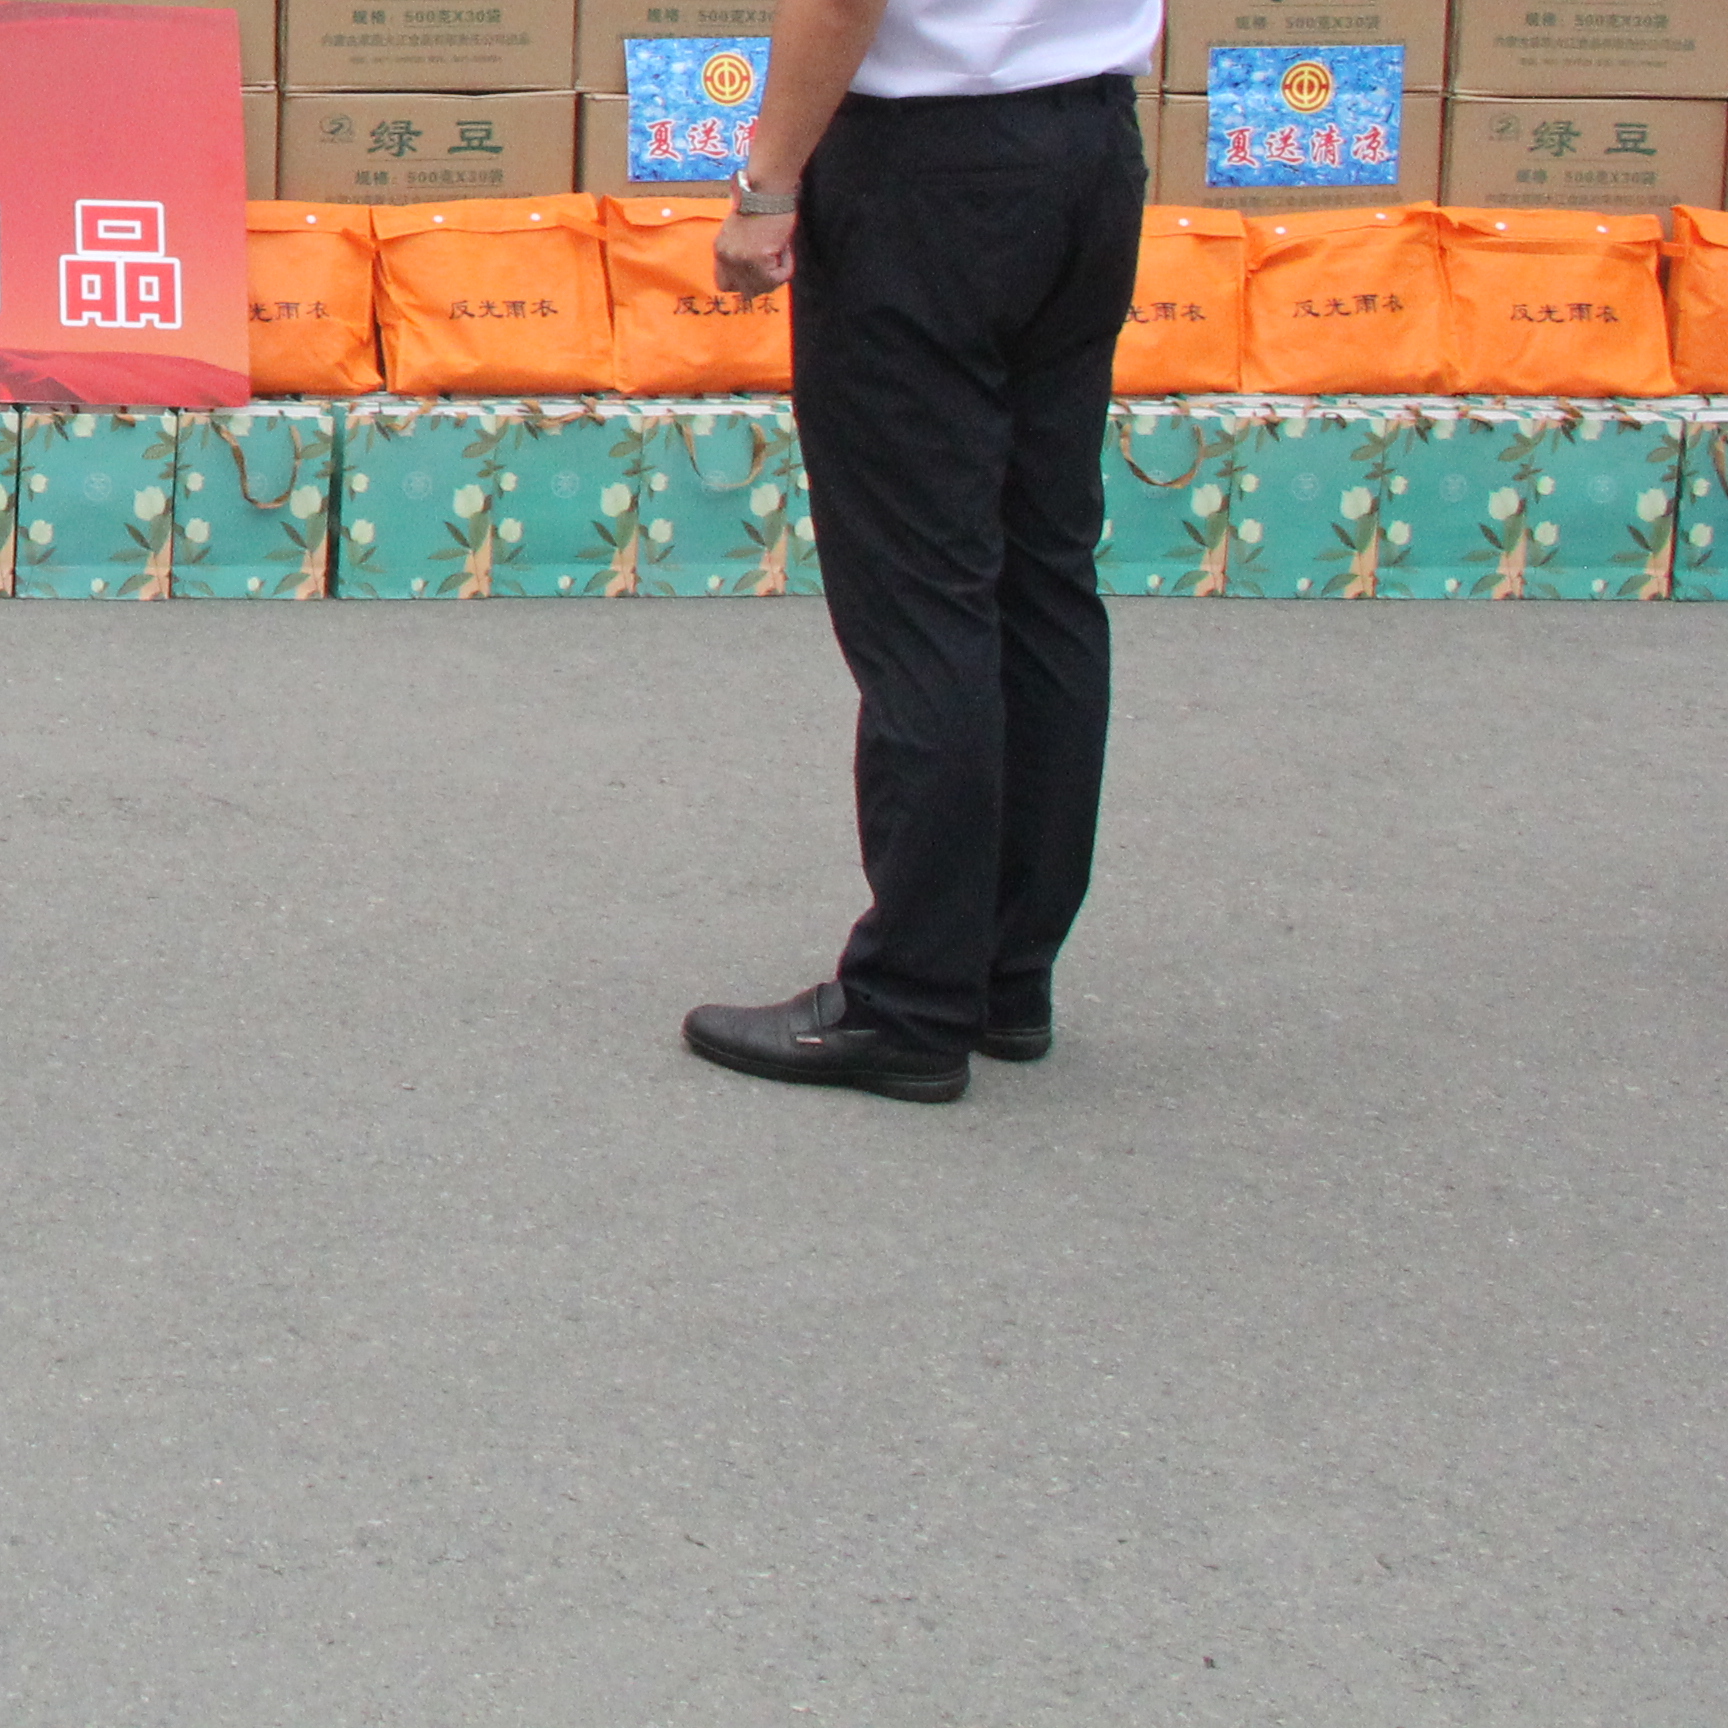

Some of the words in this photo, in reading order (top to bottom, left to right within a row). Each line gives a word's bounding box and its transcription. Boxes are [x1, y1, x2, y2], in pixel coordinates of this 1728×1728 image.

[367, 119, 504, 158] 绿豆
[1223, 124, 1391, 169] 夏送清凉
[1529, 119, 1659, 159] 绿豆
[448, 298, 559, 321] 反光雨衣
[1291, 293, 1405, 320] 反光雨衣
[1509, 301, 1620, 324] 反光雨衣
